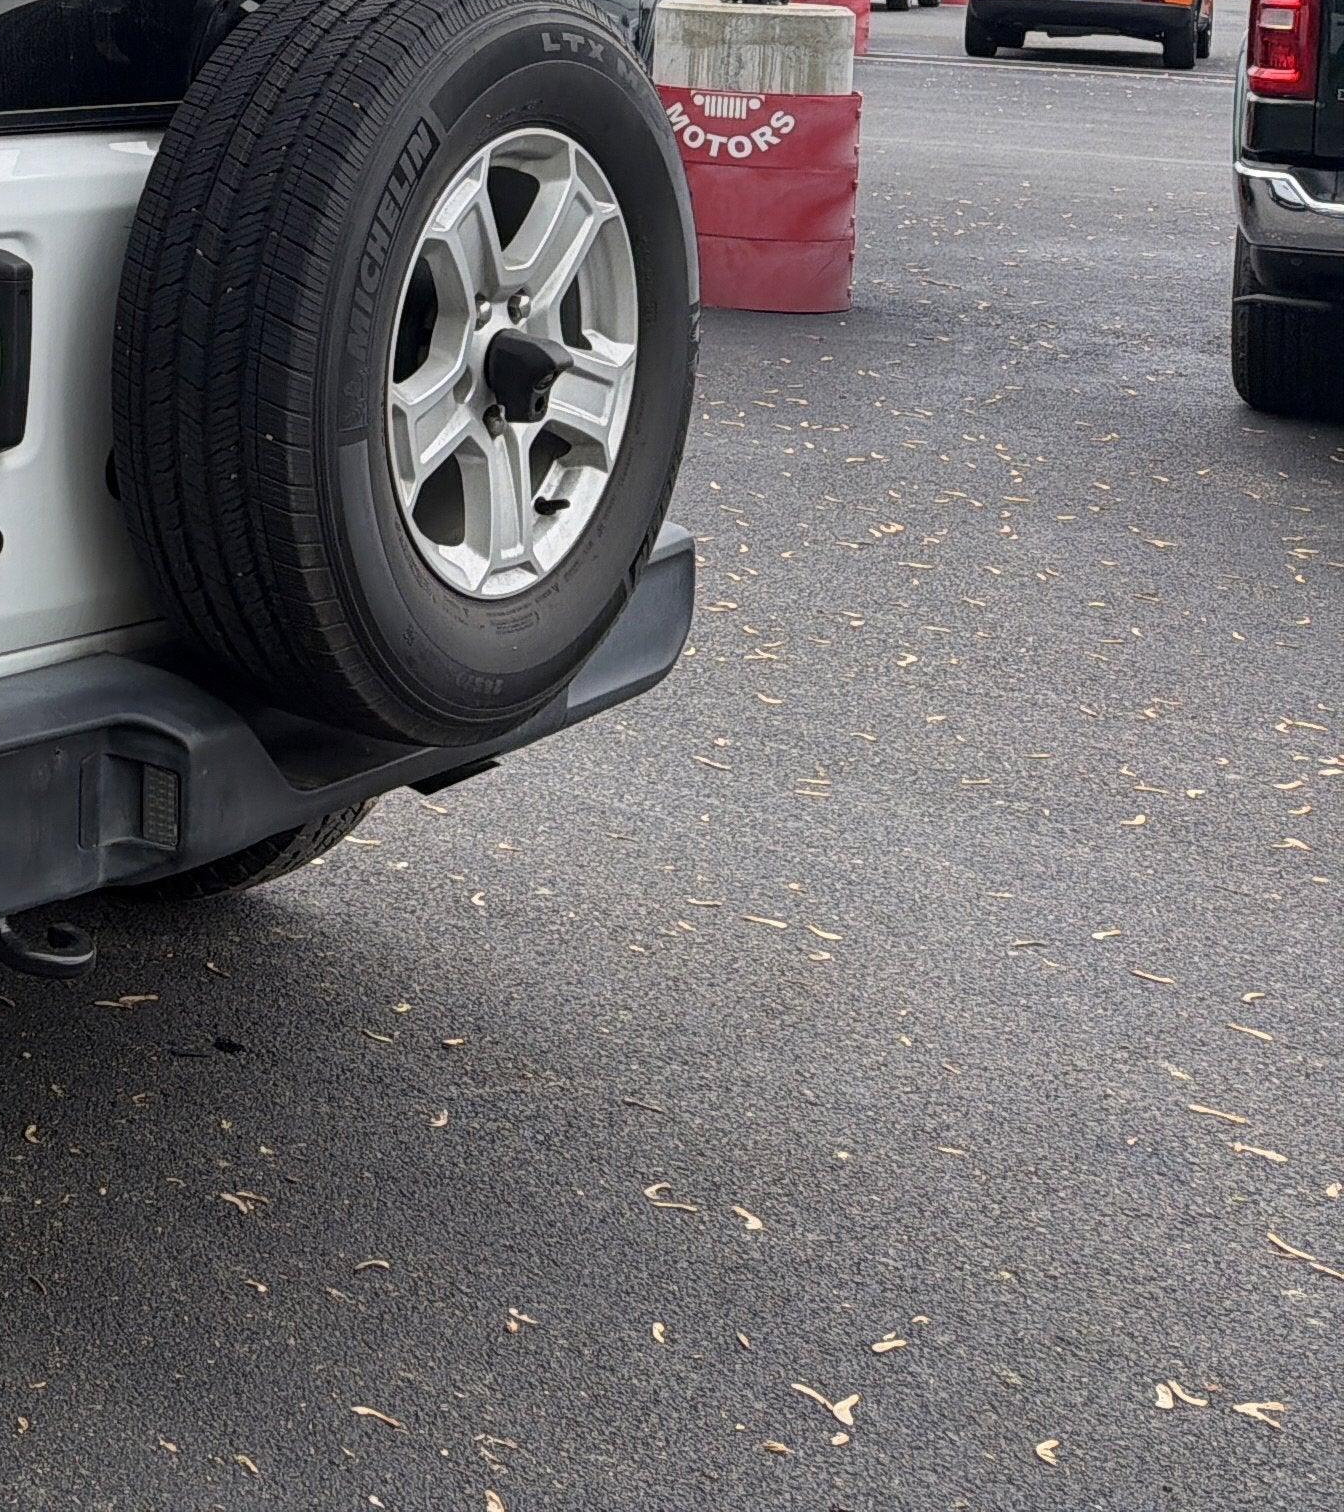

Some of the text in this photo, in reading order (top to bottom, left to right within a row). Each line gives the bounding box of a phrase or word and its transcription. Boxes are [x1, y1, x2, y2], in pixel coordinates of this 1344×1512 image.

[541, 33, 605, 62] LTX
[666, 101, 796, 159] MOTORS
[346, 118, 434, 359] MICHELIN
